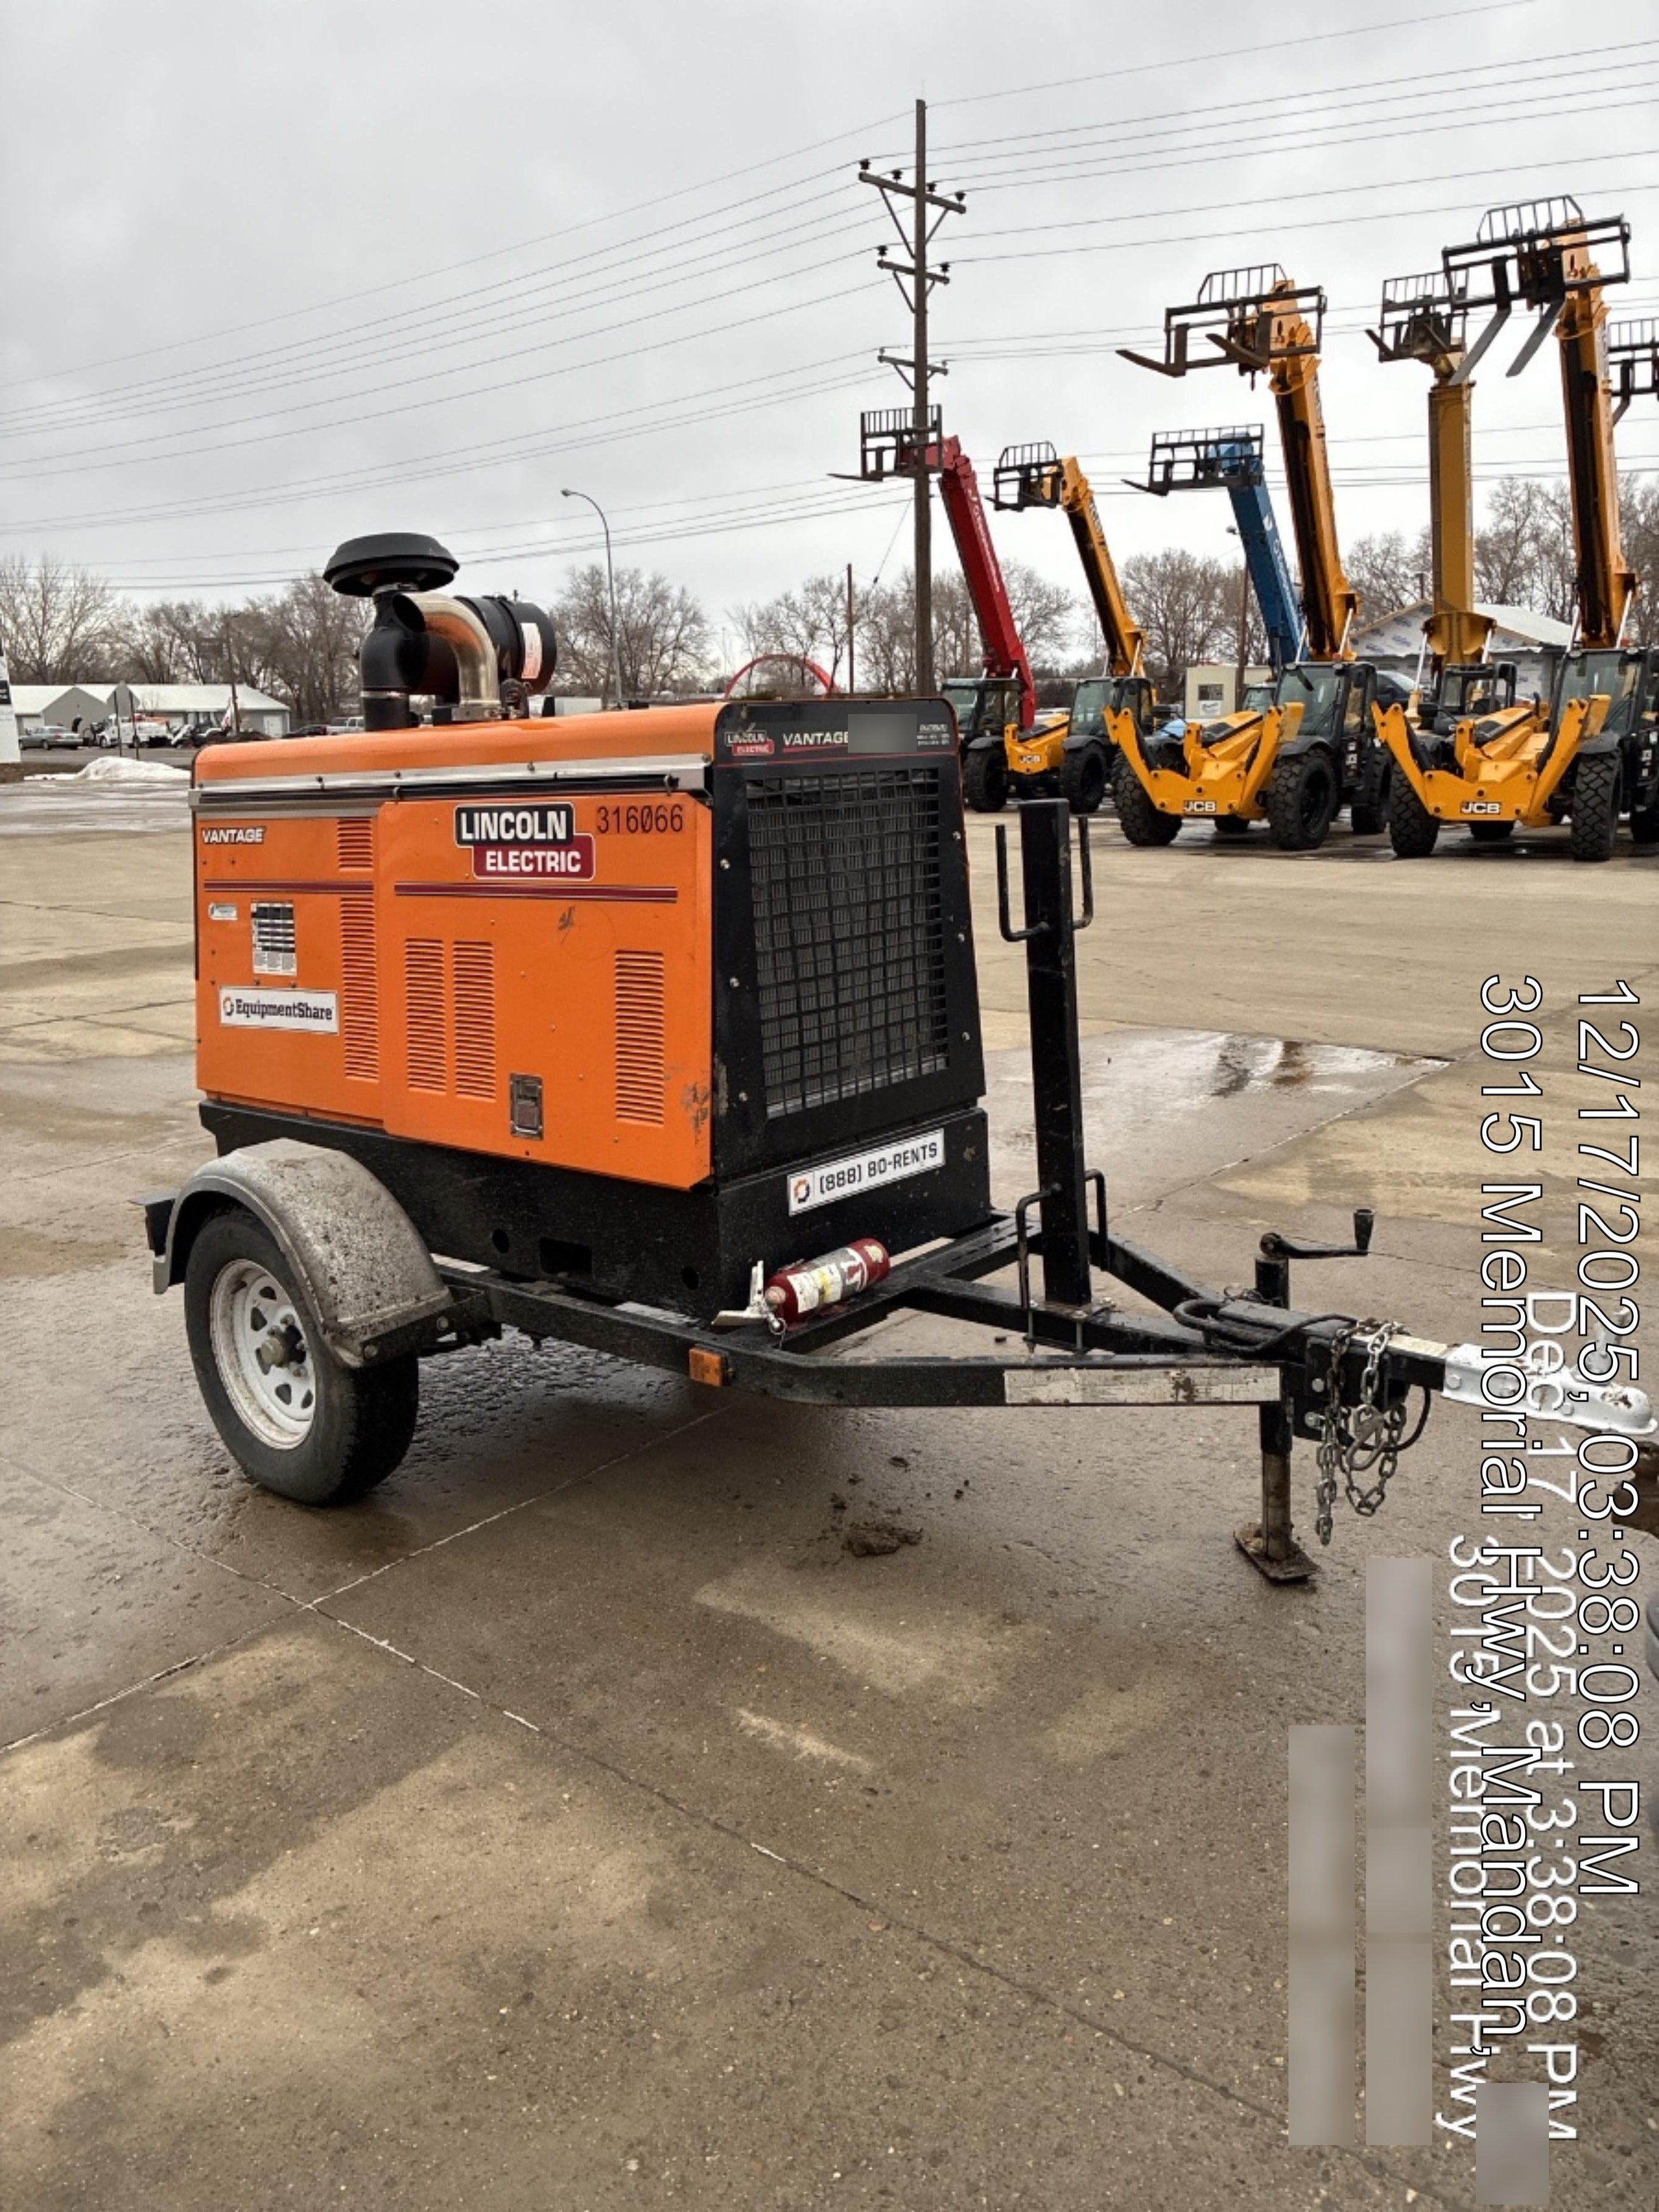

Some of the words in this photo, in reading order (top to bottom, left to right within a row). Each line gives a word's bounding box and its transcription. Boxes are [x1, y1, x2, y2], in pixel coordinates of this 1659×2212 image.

[1183, 801, 1215, 812] JCB
[1461, 802, 1500, 814] JCB
[460, 810, 567, 840] LINCOLN
[596, 804, 683, 834] 316066
[202, 828, 264, 844] VANTAGE
[485, 850, 581, 873] ELECTRIC
[235, 998, 333, 1021] EquipmentShare
[820, 1163, 862, 1195] (888)
[867, 1142, 938, 1178] 80-RENTS
